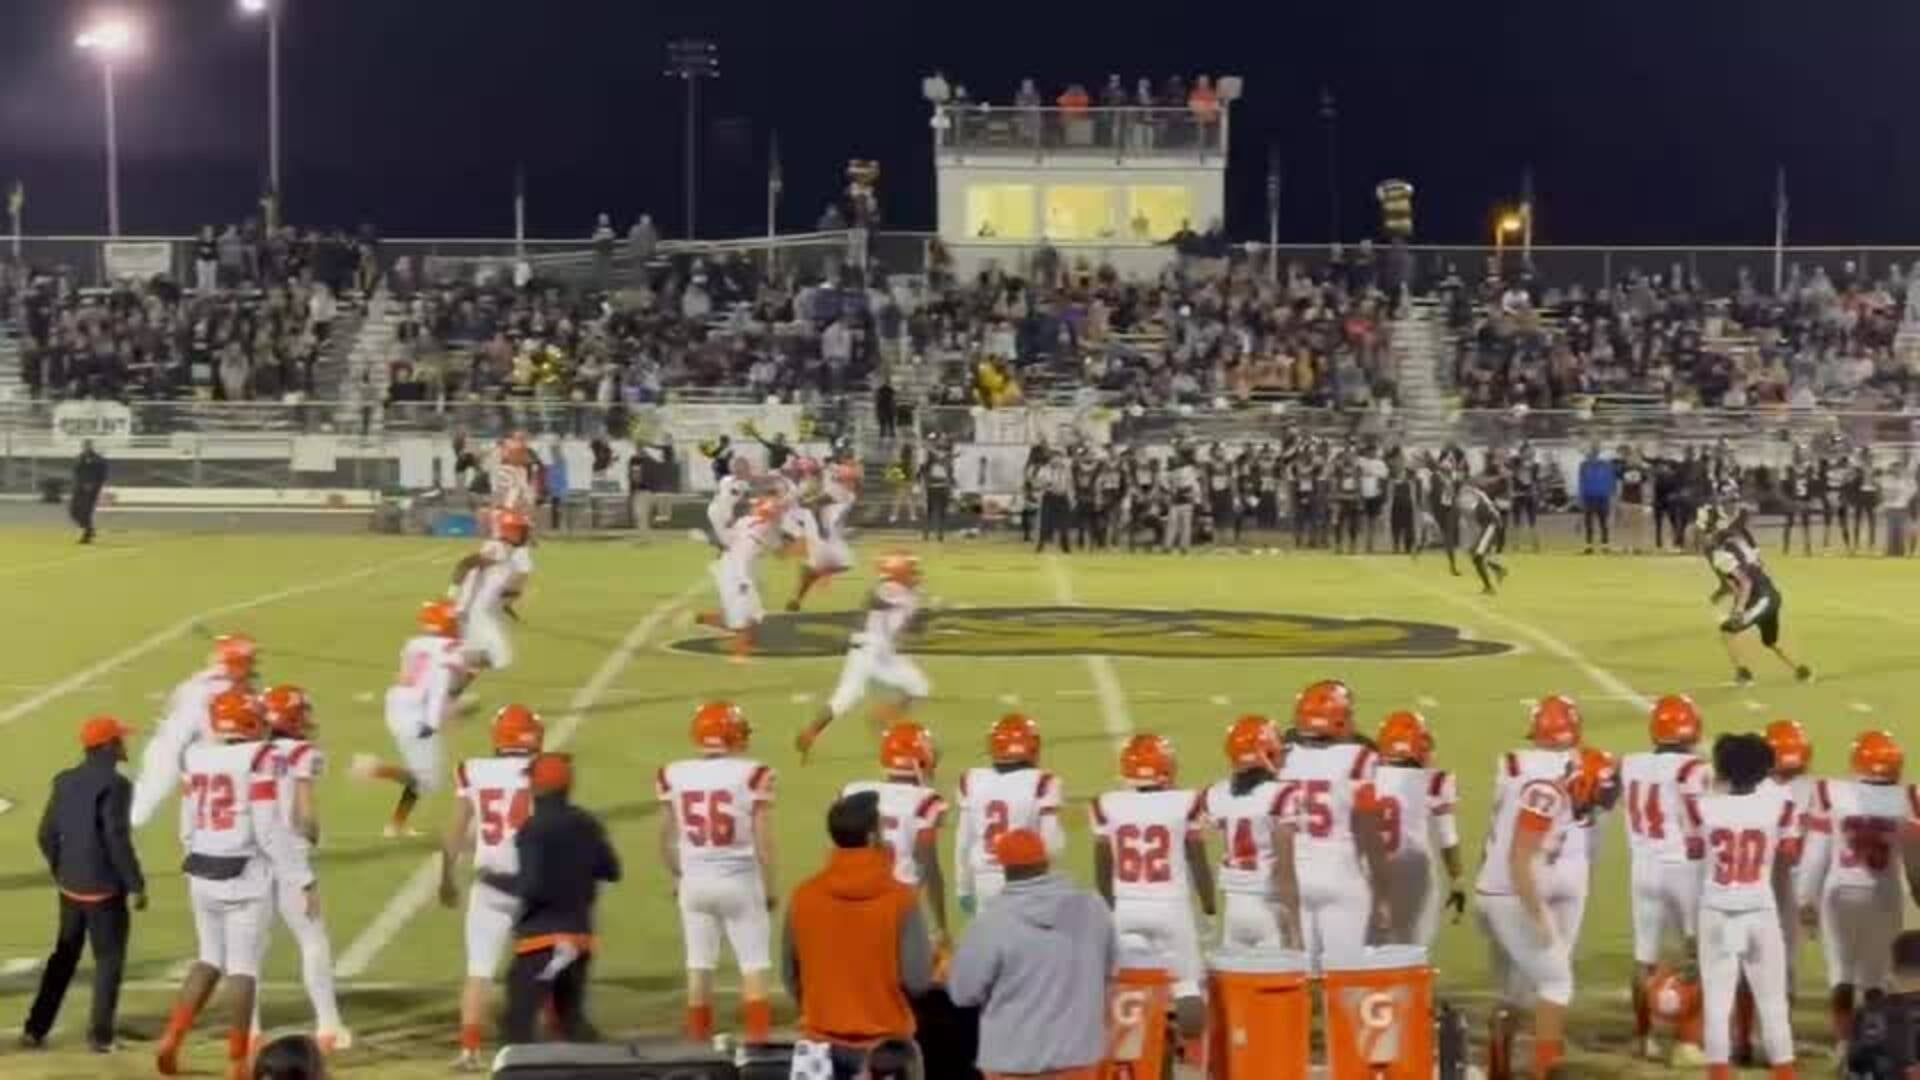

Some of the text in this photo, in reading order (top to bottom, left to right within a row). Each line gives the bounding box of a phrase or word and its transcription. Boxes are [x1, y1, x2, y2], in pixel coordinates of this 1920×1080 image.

[191, 773, 234, 830] 72
[681, 790, 734, 846] 56
[1115, 824, 1171, 882] 62
[1710, 828, 1766, 885] 30
